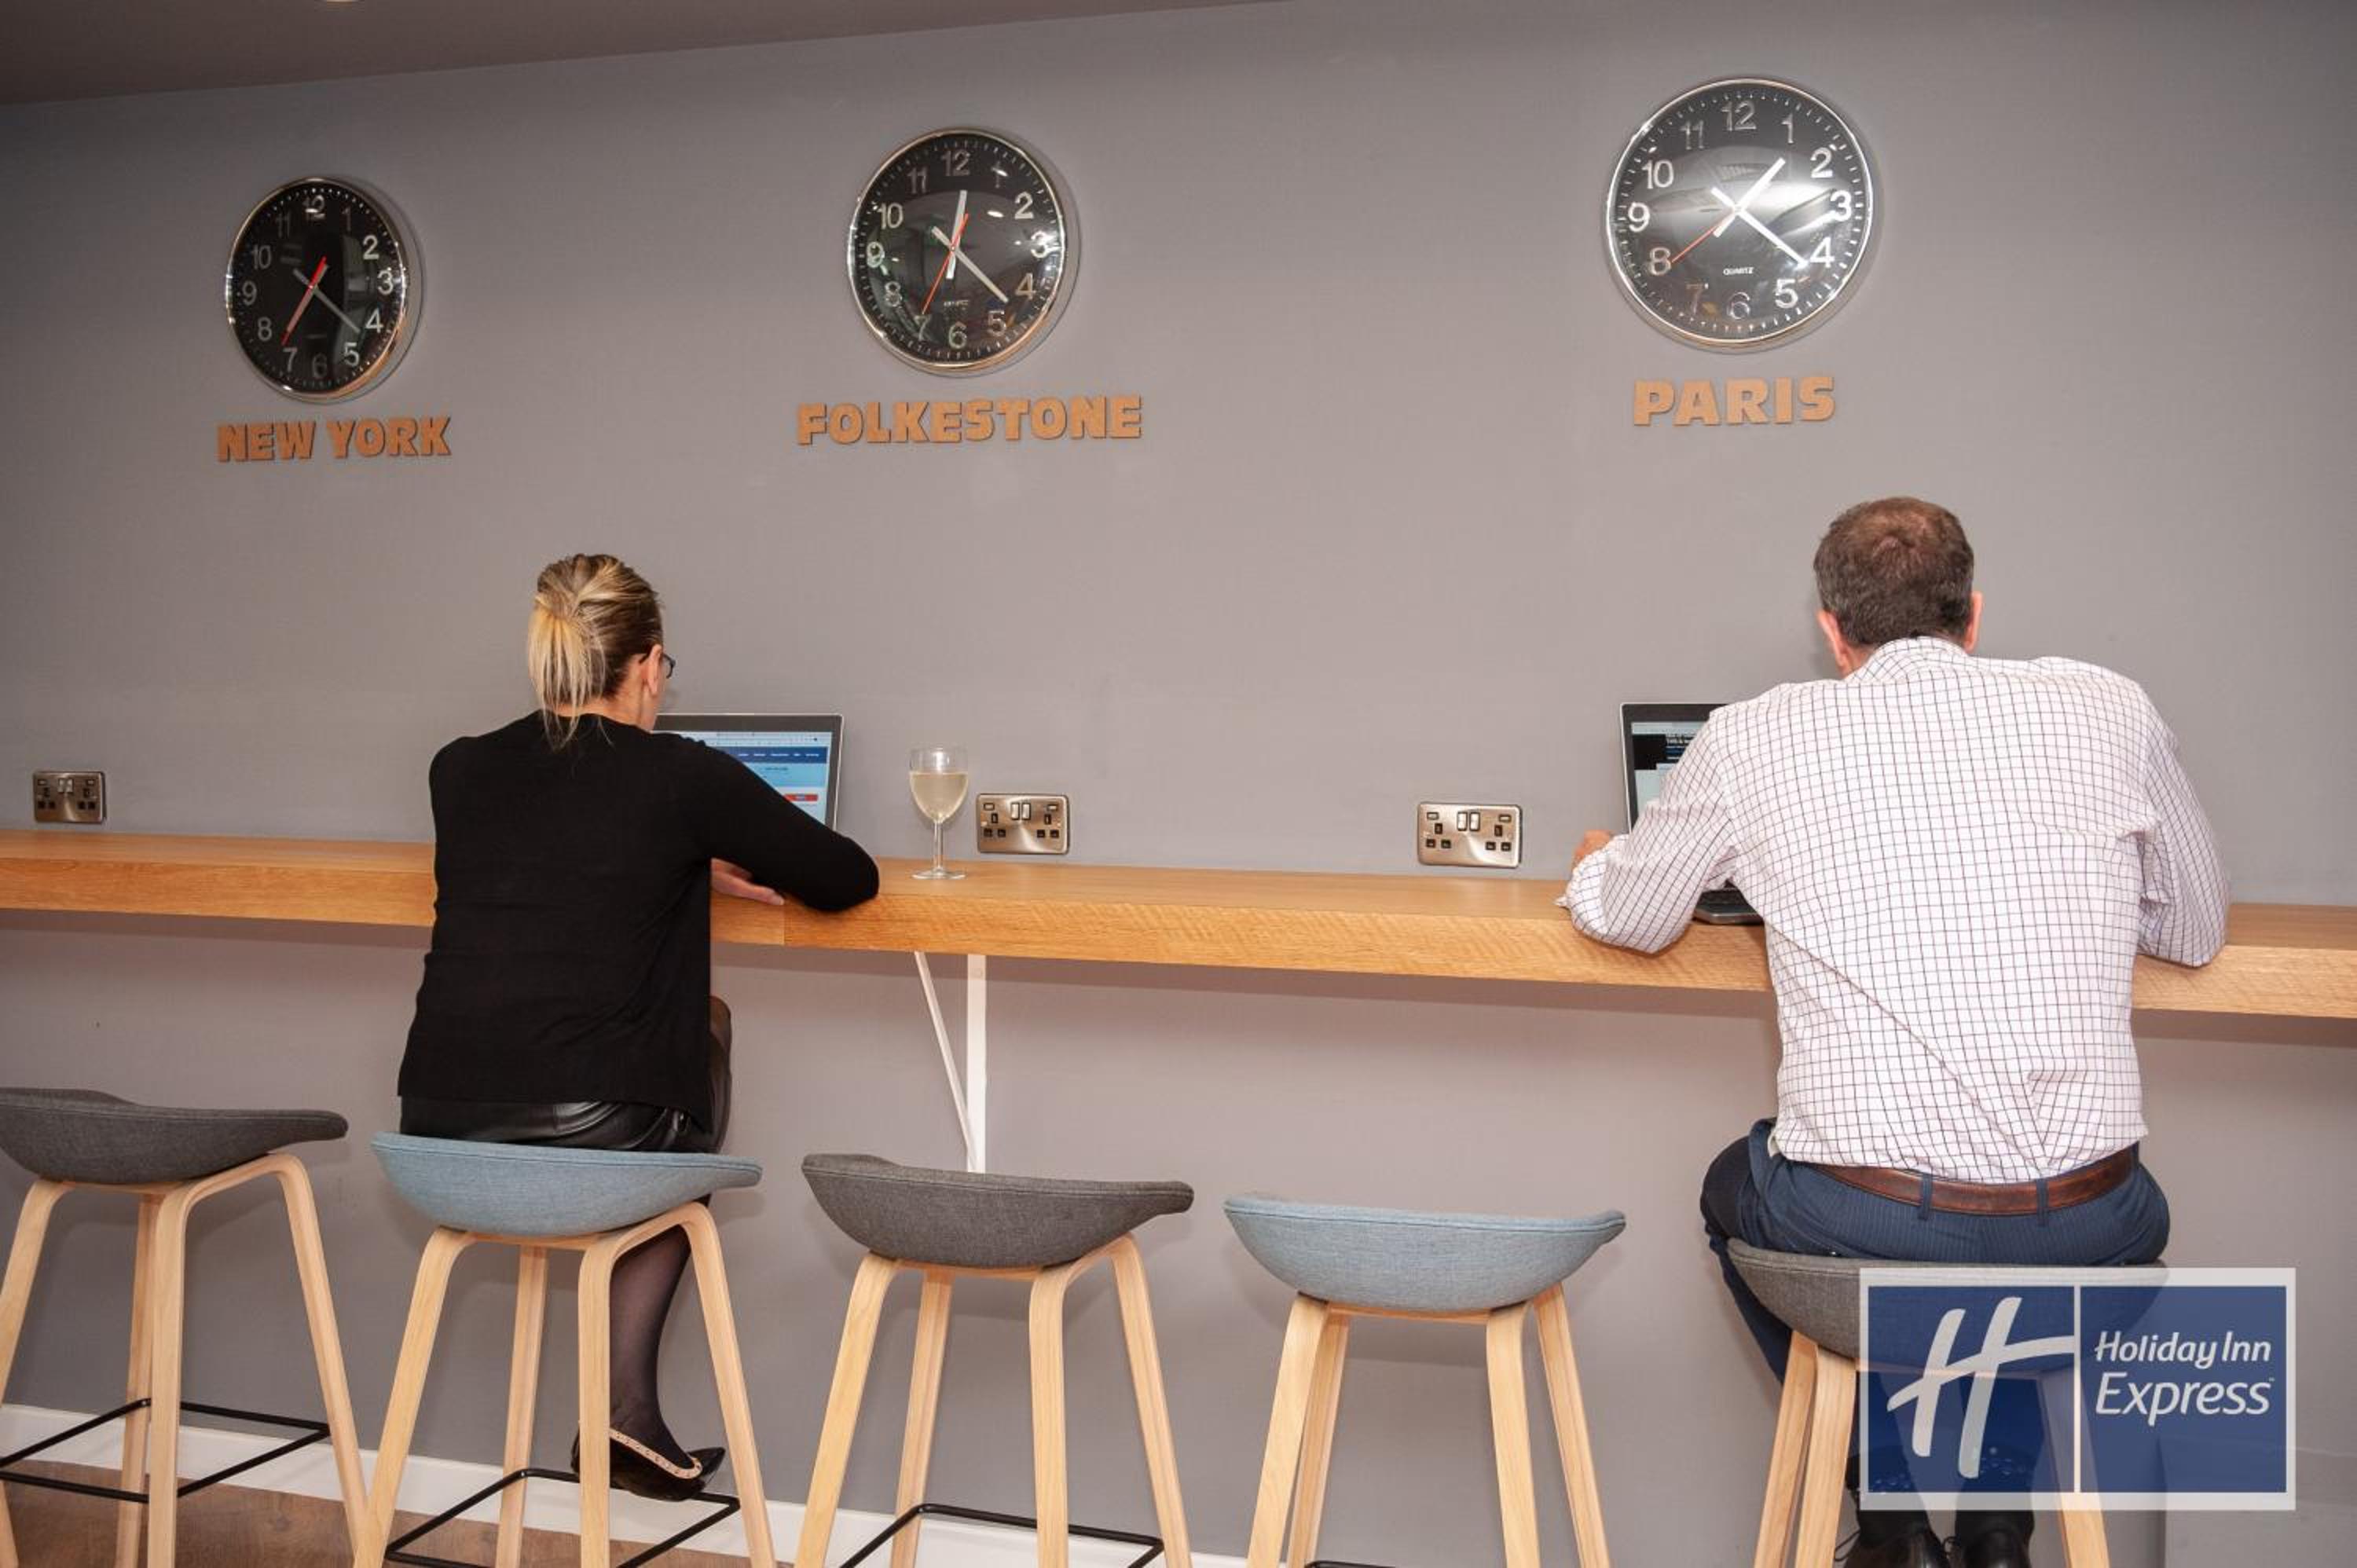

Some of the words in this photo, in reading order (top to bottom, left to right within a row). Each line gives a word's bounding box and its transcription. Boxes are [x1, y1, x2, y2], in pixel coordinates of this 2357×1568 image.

[1721, 101, 1757, 131] 12
[1782, 113, 1794, 144] 1
[1681, 119, 1706, 150] 11
[942, 150, 971, 177] 12
[1642, 159, 1674, 189] 10
[1810, 147, 1833, 178] 2
[907, 167, 929, 194] 11
[877, 203, 904, 229] 10
[1014, 192, 1034, 219] 2
[1627, 202, 1651, 233] 9
[1829, 190, 1852, 222] 3
[276, 210, 291, 238] 11
[342, 207, 351, 232] 1
[251, 244, 273, 269] 10
[362, 235, 380, 260] 2
[867, 241, 885, 268] 9
[1030, 230, 1049, 258] 3
[1809, 236, 1835, 268] 4
[1649, 247, 1671, 276] 8
[242, 280, 258, 306] 9
[377, 270, 394, 295] 3
[885, 281, 902, 308] 8
[1015, 273, 1036, 300] 4
[1774, 279, 1798, 309] 5
[1686, 284, 1703, 315] 7
[1727, 291, 1750, 320] 6
[258, 316, 273, 341] 8
[365, 309, 383, 333] 4
[914, 314, 930, 341] 7
[988, 310, 1006, 337] 5
[948, 321, 968, 350] 6
[283, 347, 298, 372] 7
[312, 354, 328, 379] 6
[343, 343, 360, 367] 5
[1633, 376, 1836, 427] PARIS
[797, 395, 1143, 445] FOLKESTONE
[217, 419, 317, 463] NEW
[326, 416, 453, 459] YORK
